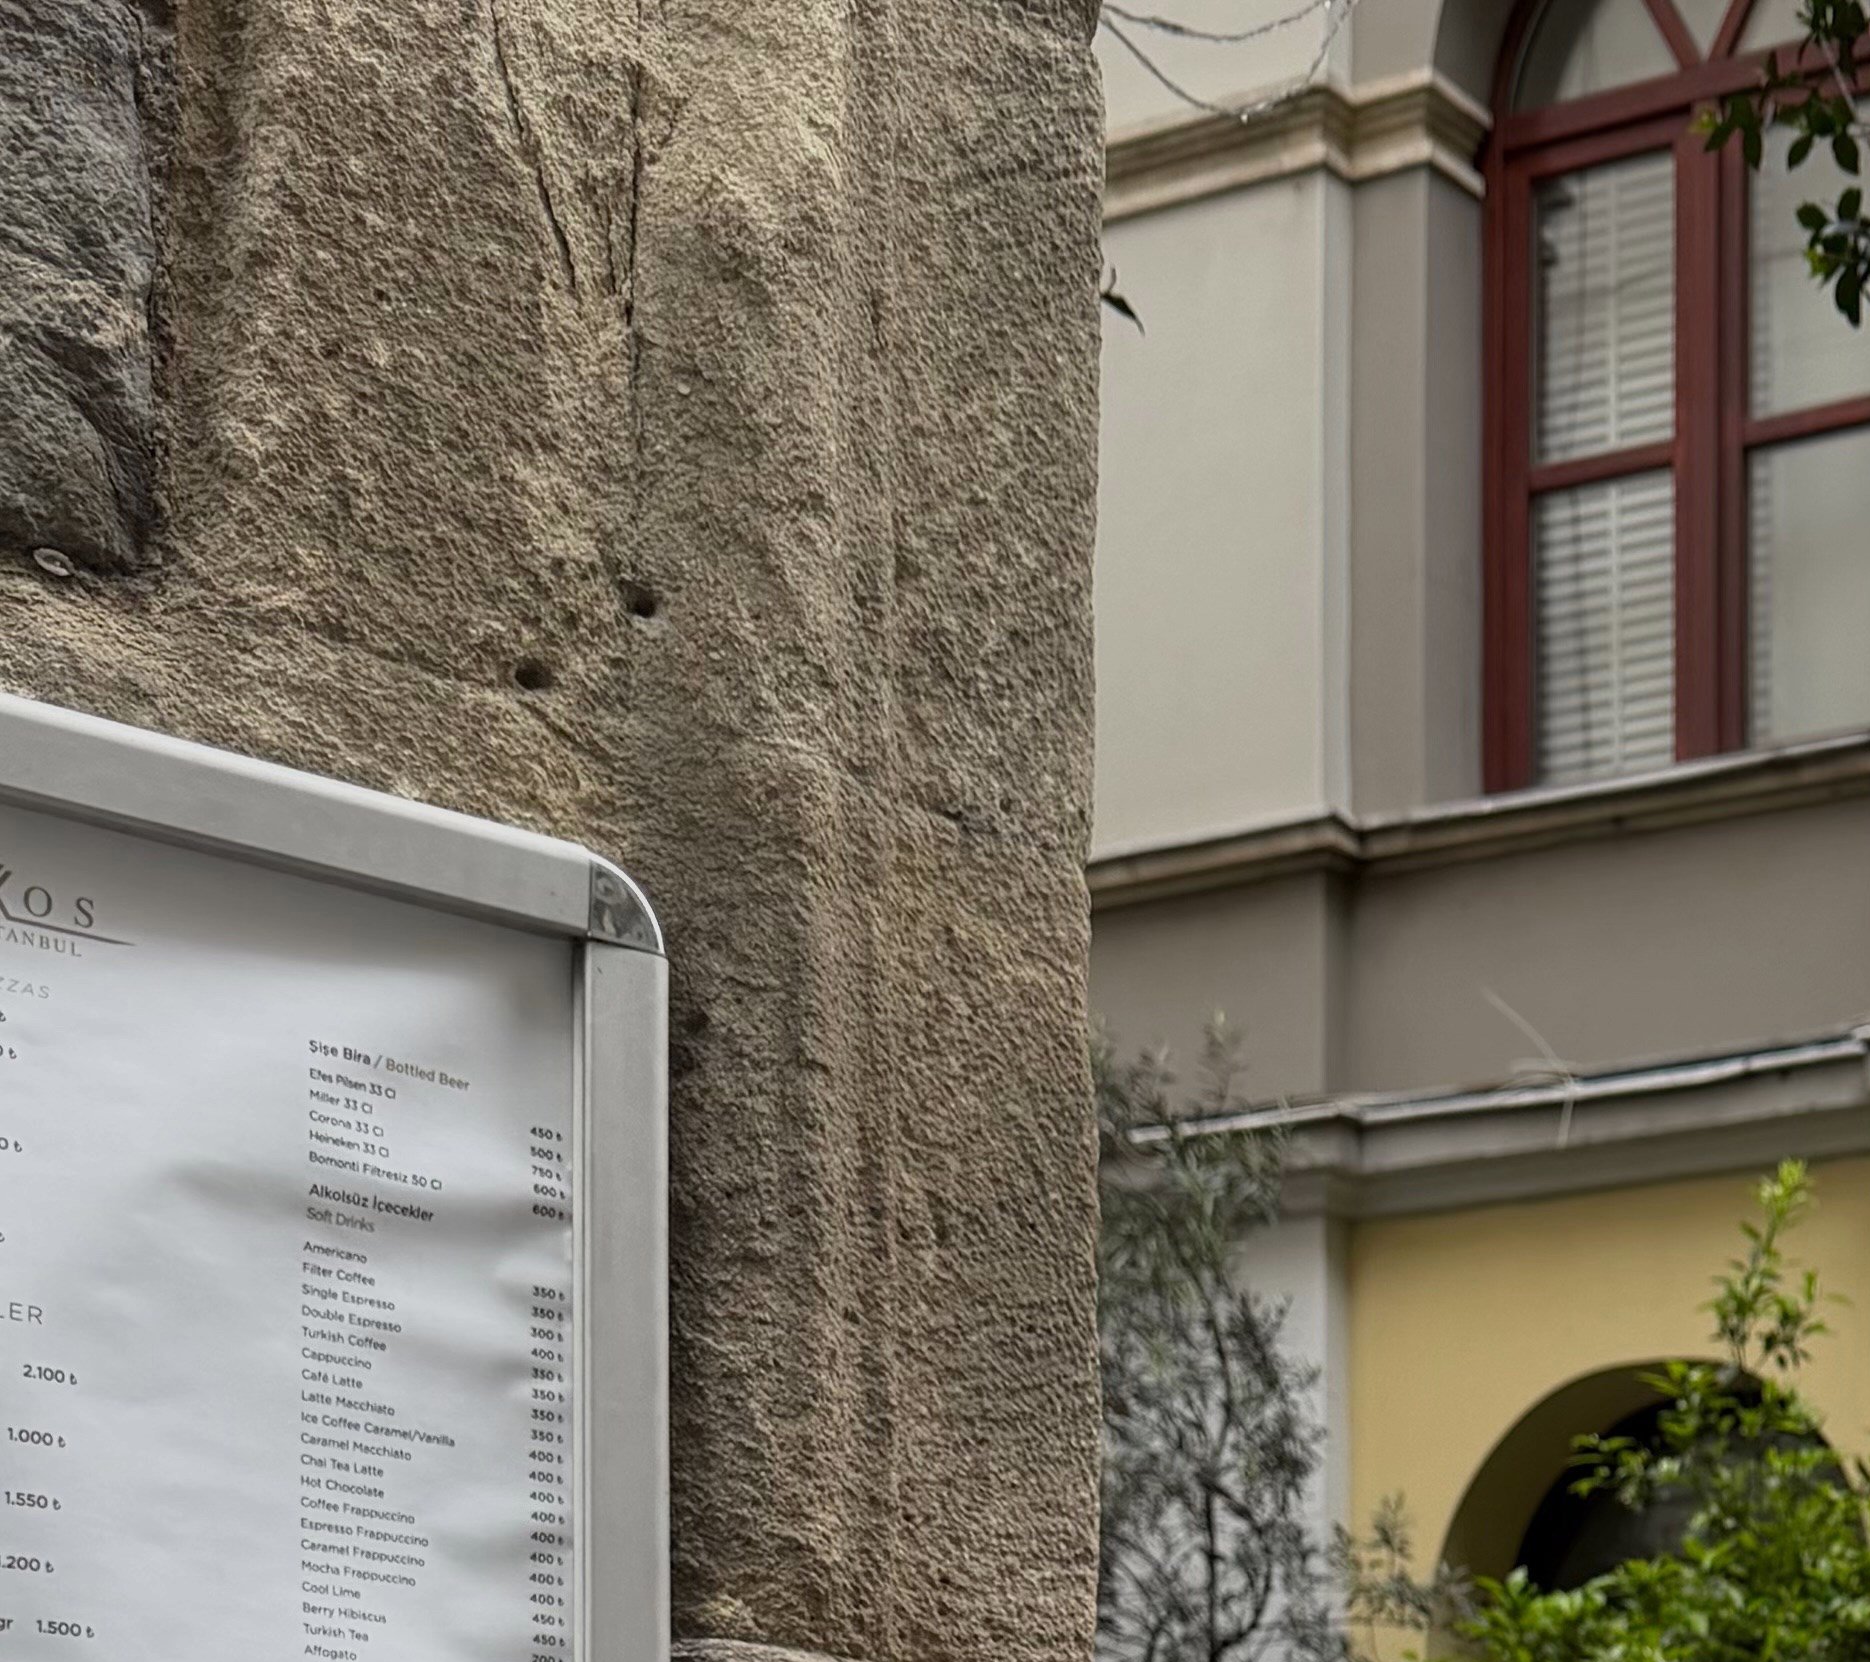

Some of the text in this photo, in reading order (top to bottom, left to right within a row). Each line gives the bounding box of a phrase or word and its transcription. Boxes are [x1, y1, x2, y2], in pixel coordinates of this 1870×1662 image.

[309, 1040, 338, 1057] Şişe
[343, 1046, 371, 1066] Bira
[386, 1058, 435, 1082] Bottled
[439, 1072, 470, 1089] Beer
[310, 1089, 340, 1106] Miller
[344, 1097, 358, 1111] 33
[309, 1110, 352, 1130] Corona
[309, 1129, 360, 1150] Heineken
[309, 1184, 434, 1222] Alkolsüz İçecekler
[306, 1206, 375, 1232] Soft Drinks
[303, 1241, 367, 1264] Americano
[302, 1262, 375, 1286] Filter Coffee
[302, 1283, 395, 1311] Single Espresso
[532, 1285, 556, 1300] 350
[0, 1302, 42, 1325] ER
[302, 1304, 402, 1333] Double Espresso
[302, 1326, 387, 1352] Turkish Coffee
[301, 1347, 372, 1370] Cappuccino
[23, 1364, 65, 1384] 2.100
[301, 1368, 363, 1389] Café Latte
[301, 1390, 395, 1416] Latte Macchiato
[7, 1427, 54, 1446] 1.000
[300, 1432, 412, 1461] Caramel Macchiato
[300, 1454, 384, 1478] Chai Tea Latte
[300, 1475, 384, 1498] Hot Chocolate
[4, 1491, 48, 1509] 1.550
[0, 1555, 41, 1573] .200
[301, 1560, 416, 1587] Mocha Frappuccino
[301, 1581, 361, 1599] Cool Lime
[302, 1601, 387, 1624] Berry Hibiscus
[36, 1619, 82, 1637] 1.500
[303, 1622, 369, 1642] Turkish Tea
[304, 1645, 357, 1661] Affogato
